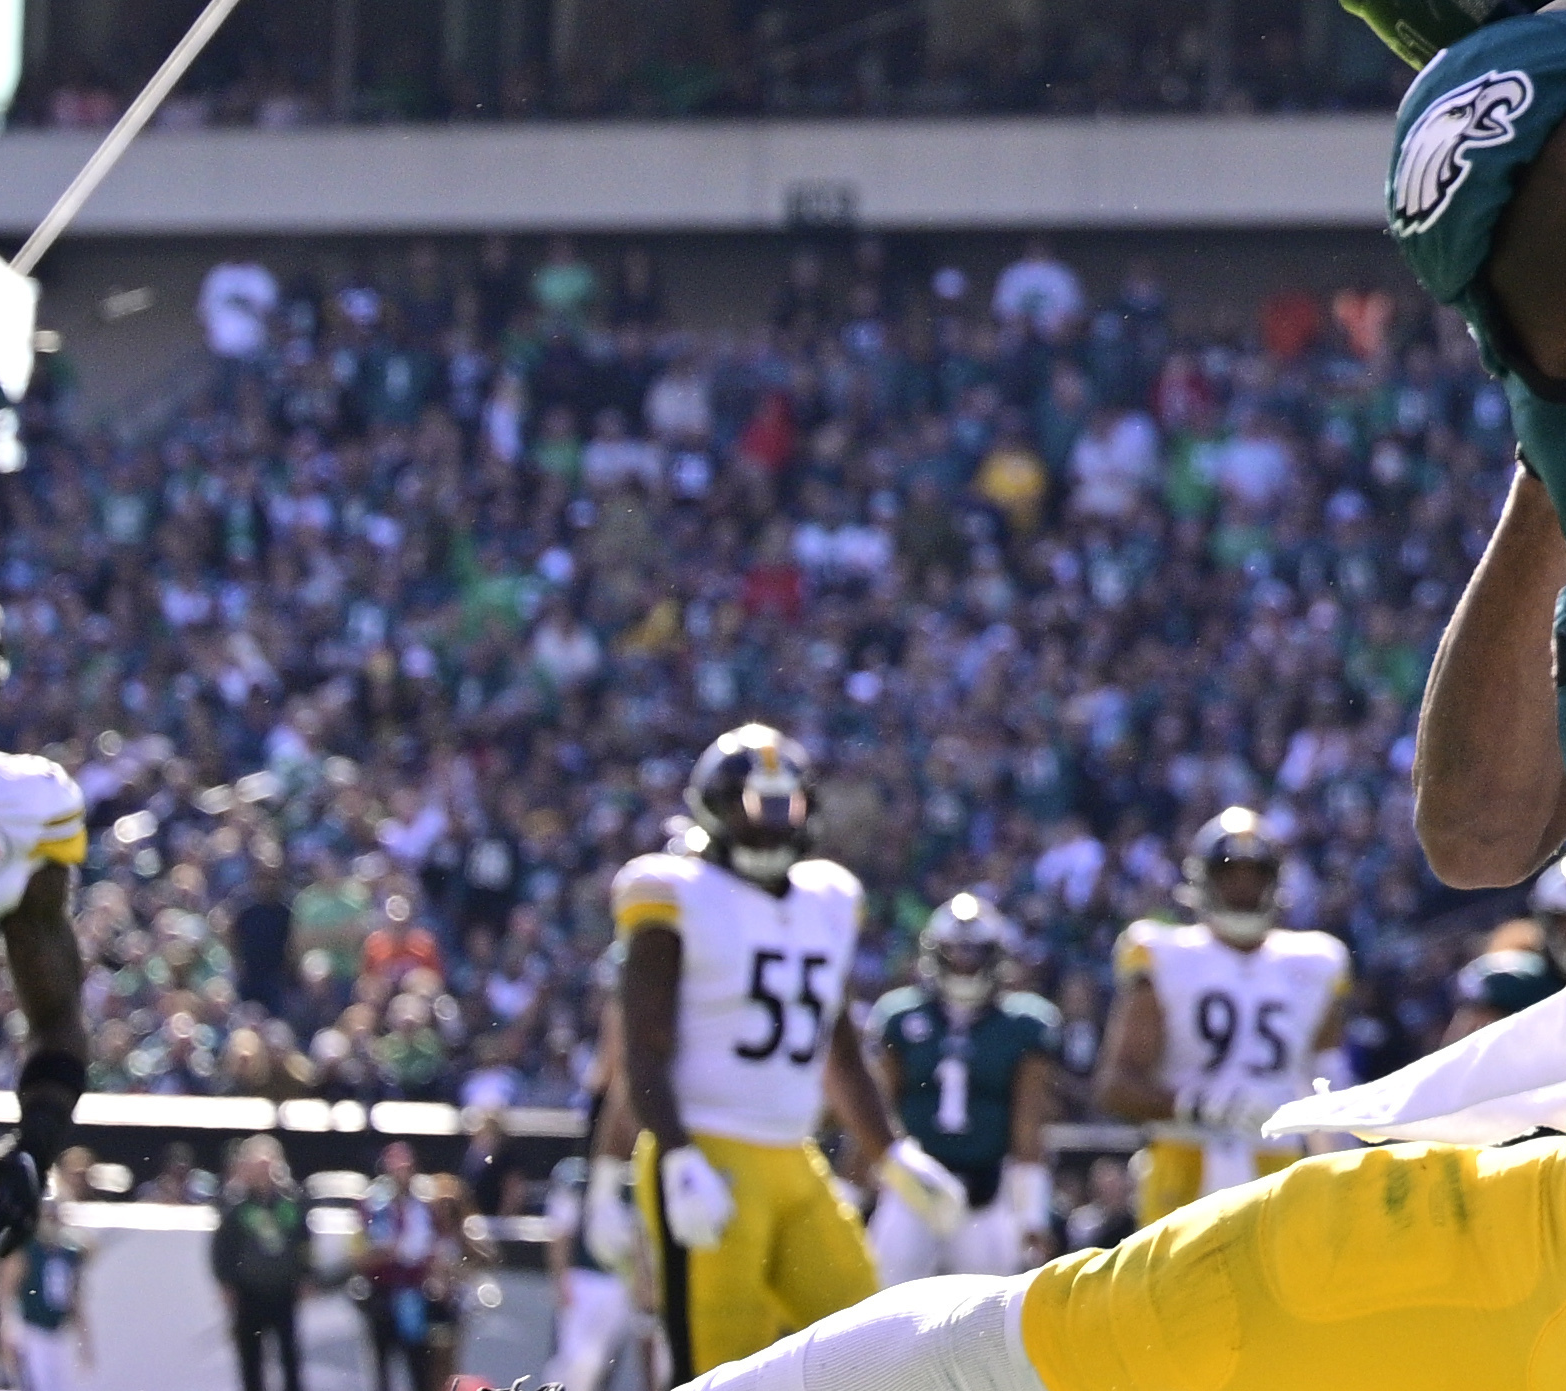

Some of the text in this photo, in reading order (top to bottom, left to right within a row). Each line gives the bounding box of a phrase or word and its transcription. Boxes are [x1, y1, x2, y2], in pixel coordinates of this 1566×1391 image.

[735, 949, 827, 1064] 55
[1197, 988, 1291, 1078] 95
[934, 1057, 969, 1135] 1
